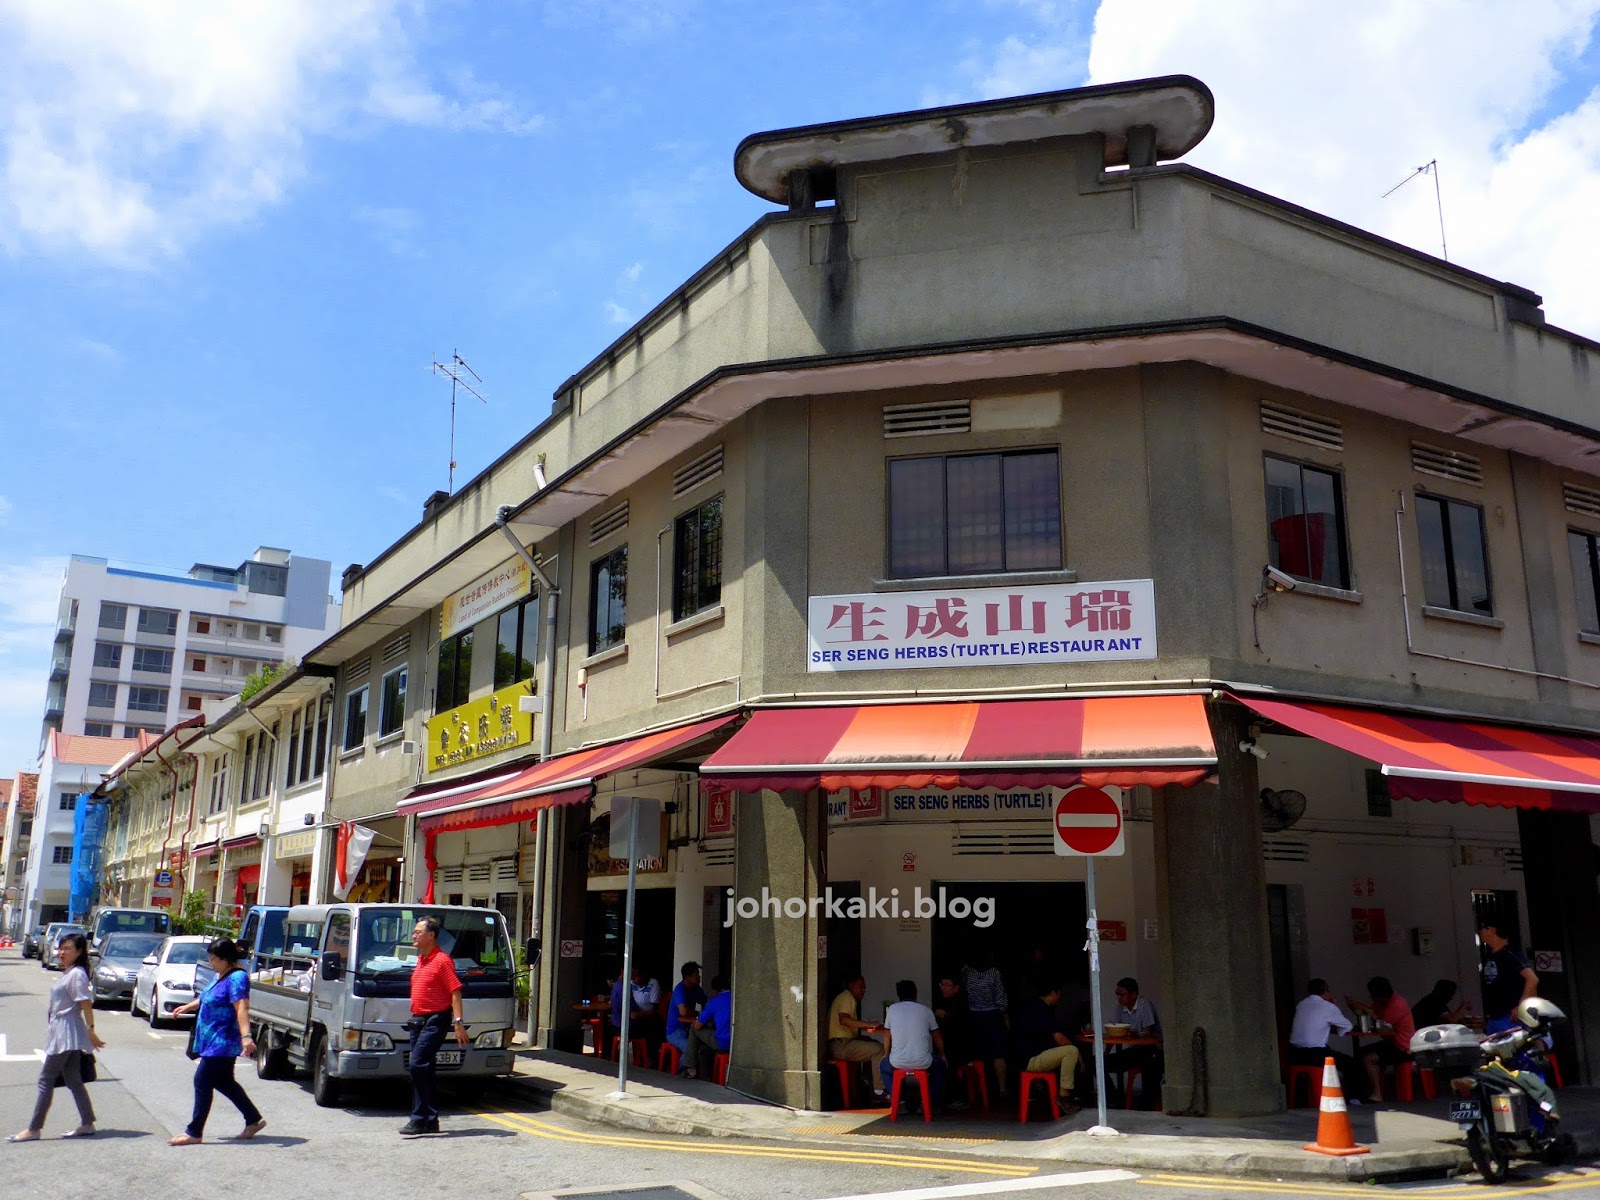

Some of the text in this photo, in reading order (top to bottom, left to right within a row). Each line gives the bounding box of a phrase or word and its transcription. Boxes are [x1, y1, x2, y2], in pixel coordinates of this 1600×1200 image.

[826, 590, 1132, 644] 生成山瑞
[812, 650, 842, 663] SER
[847, 647, 889, 661] SENG
[827, 801, 847, 816] RANT
[894, 794, 916, 811] SER
[919, 793, 949, 810] SENG
[952, 793, 990, 810] HERBS
[994, 791, 1045, 811] (TURTLE)
